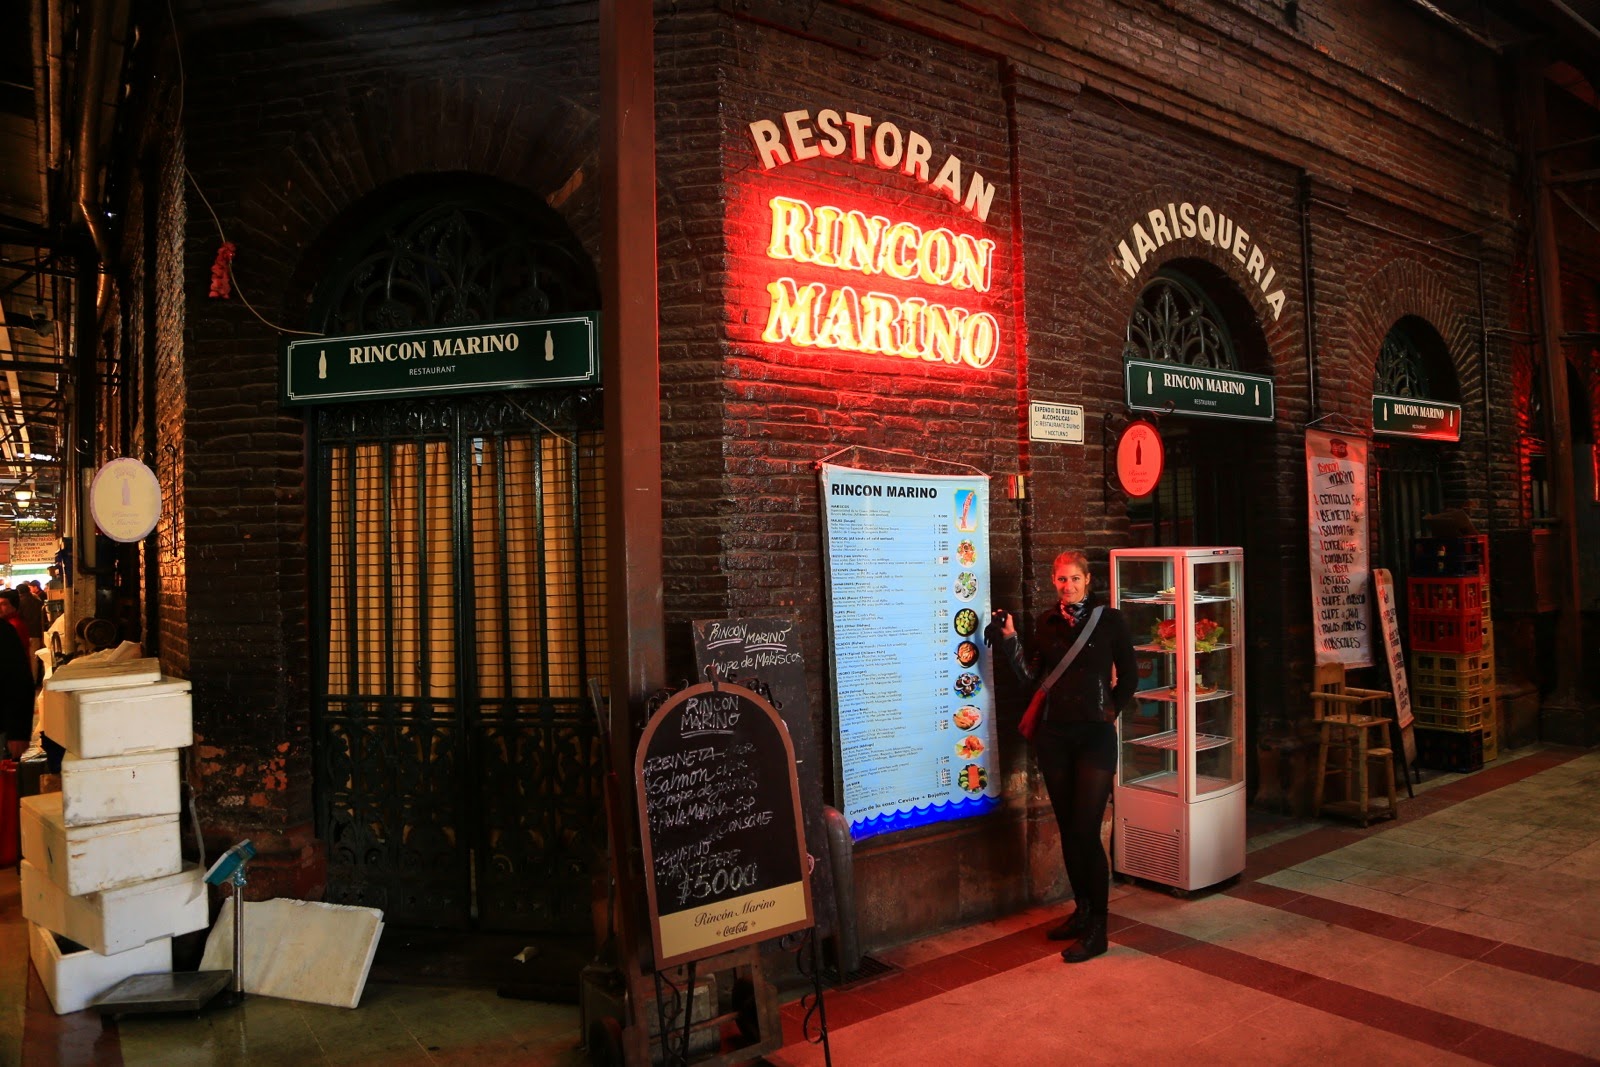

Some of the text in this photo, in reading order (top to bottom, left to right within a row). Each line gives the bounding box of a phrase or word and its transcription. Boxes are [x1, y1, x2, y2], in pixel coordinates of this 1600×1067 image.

[749, 108, 996, 223] RESTORAN
[766, 196, 996, 293] RINCON
[1108, 203, 1286, 321] MARISQUERIA
[761, 277, 1000, 369] MARINO
[349, 332, 519, 365] RINCON MARINO
[409, 365, 456, 376] RESTAURANT
[1163, 373, 1245, 396] RINCON MARINO
[1394, 403, 1444, 419] RINCON MARINO
[832, 483, 938, 499] RINCON MARINO
[709, 622, 748, 641] RINCON
[741, 655, 753, 667] de
[686, 695, 739, 714] RINCON
[680, 712, 741, 730] MARINO
[897, 796, 920, 804] Ceviche
[694, 899, 776, 927] Rincón Marino
